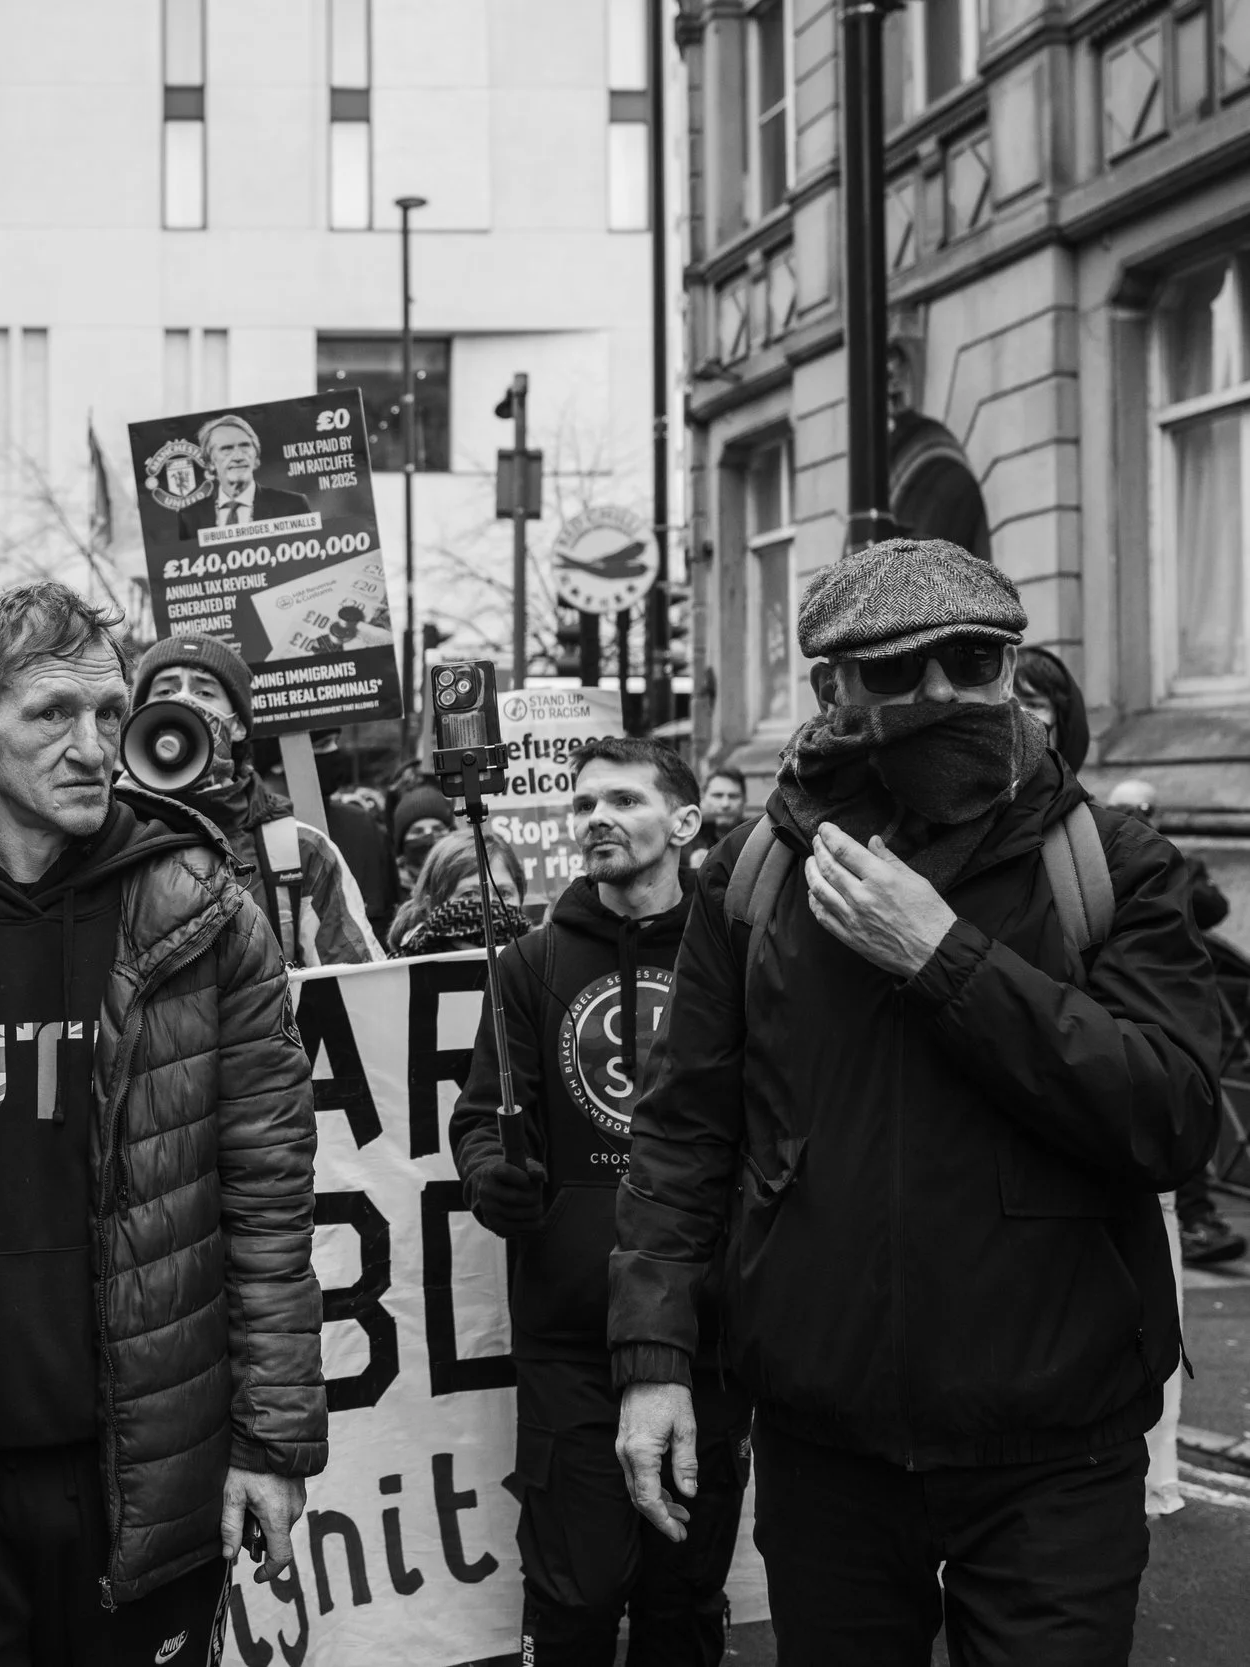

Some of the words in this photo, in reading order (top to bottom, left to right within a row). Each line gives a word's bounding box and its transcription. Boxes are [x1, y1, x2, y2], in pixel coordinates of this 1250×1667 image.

[316, 408, 351, 432] £0
[283, 444, 298, 459] UK
[298, 441, 316, 456] TAX
[315, 438, 339, 454] PAID
[339, 435, 353, 451] BY
[288, 461, 306, 477] JIM
[306, 453, 356, 474] RATCLIFFE
[318, 476, 331, 491] IN
[330, 471, 358, 489] 2025
[163, 531, 371, 579] £140,000,000,000
[165, 582, 205, 601] ANNUAL
[204, 579, 223, 595] TAX
[222, 572, 269, 592] REVENUE
[352, 579, 377, 593] £20
[167, 597, 223, 619] GENERATED
[223, 594, 237, 611] BY
[170, 614, 233, 637] IMMIGRANTS
[302, 610, 330, 629] £10
[286, 661, 357, 685] IMMIGRANTS
[267, 692, 289, 708] THE
[289, 688, 318, 705] REAL
[529, 693, 565, 708] STAND
[568, 693, 584, 706] UP
[290, 711, 301, 720] AND
[301, 710, 310, 719] THE
[310, 705, 343, 717] GOVERNMENT
[343, 703, 355, 712] THAT
[529, 708, 546, 721] TO
[548, 706, 591, 719] RACISM
[491, 812, 559, 850] Stop
[562, 1031, 573, 1074] BLACK
[161, 1629, 187, 1653] NIKE
